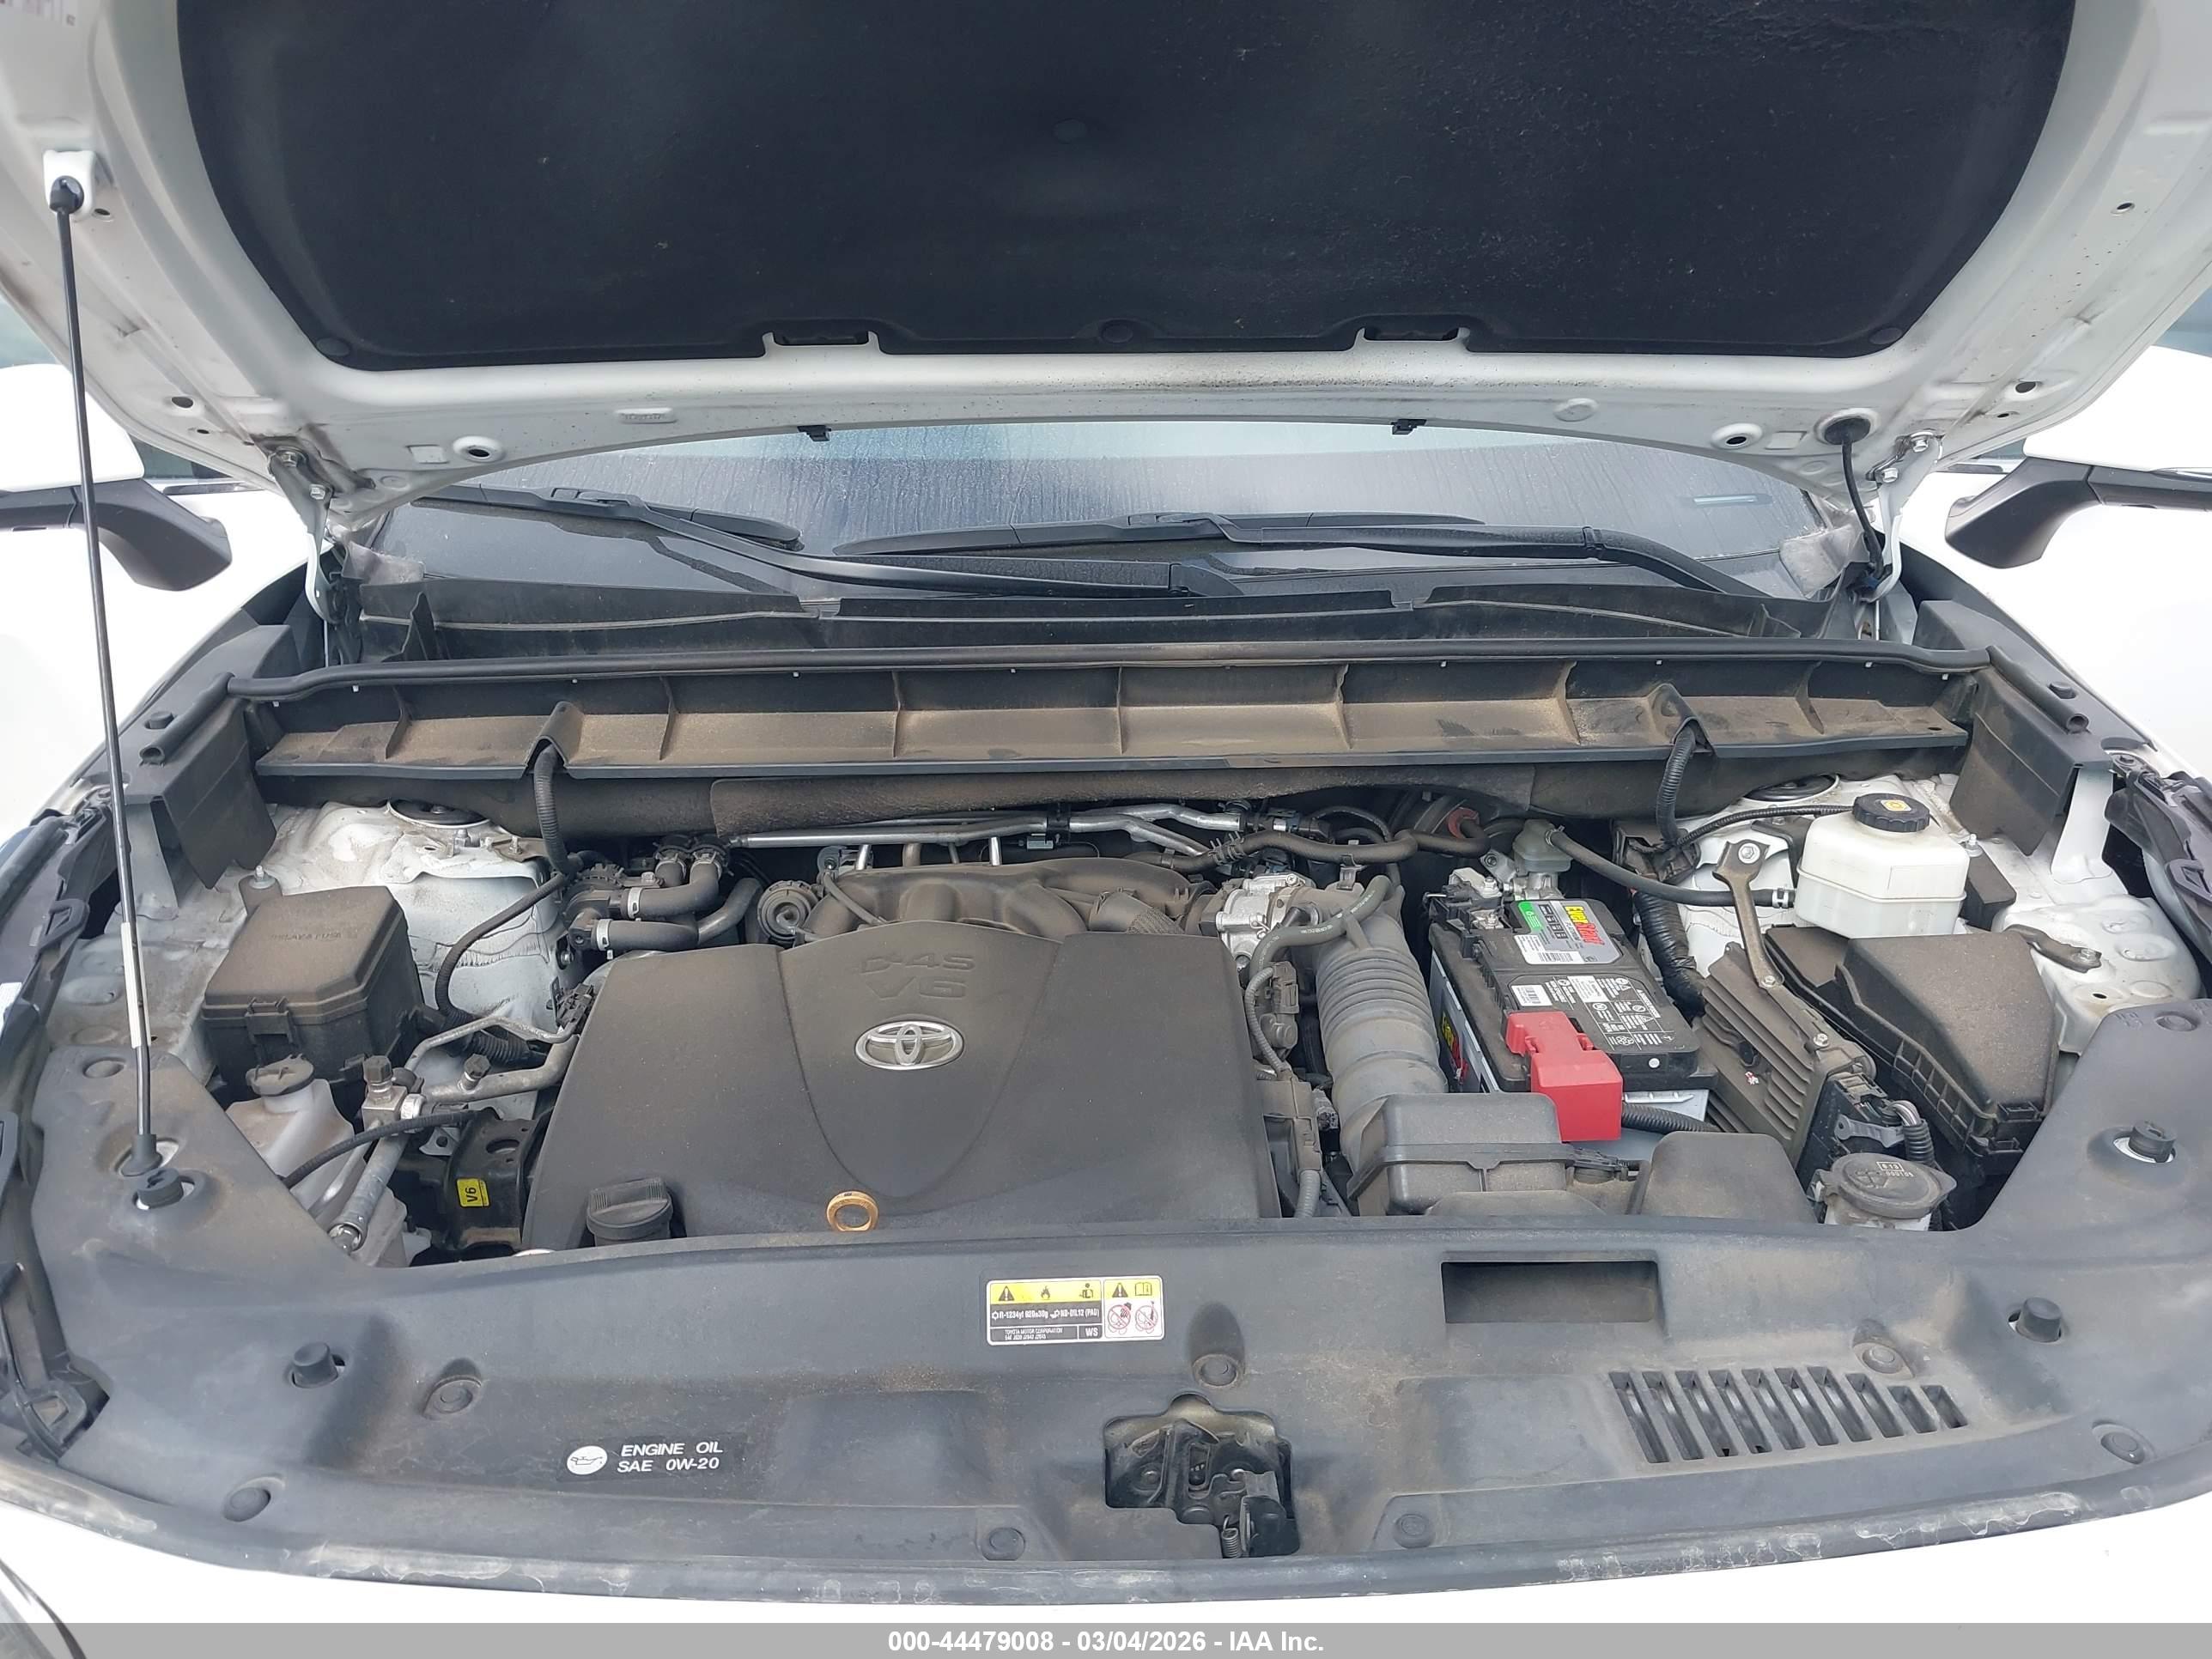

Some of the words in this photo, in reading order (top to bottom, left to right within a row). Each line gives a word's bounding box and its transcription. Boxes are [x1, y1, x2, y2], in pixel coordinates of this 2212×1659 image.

[864, 976, 969, 1000] V6
[465, 1187, 478, 1202] V6
[1085, 1328, 1098, 1337] WS
[621, 1443, 685, 1457] ENGINE
[696, 1442, 723, 1454] OIL
[617, 1460, 653, 1473] SAE
[665, 1457, 720, 1471] 0W-20
